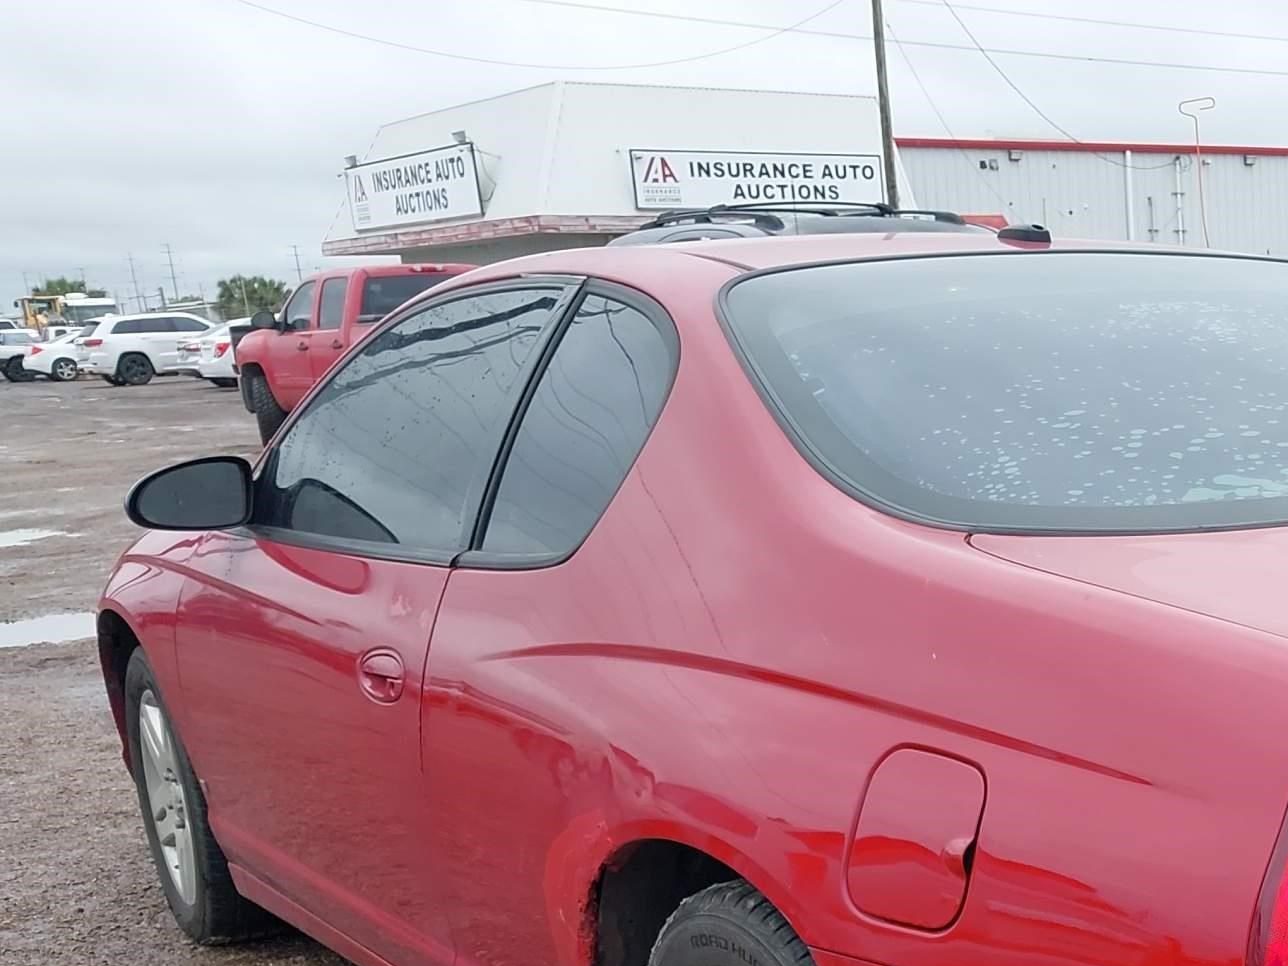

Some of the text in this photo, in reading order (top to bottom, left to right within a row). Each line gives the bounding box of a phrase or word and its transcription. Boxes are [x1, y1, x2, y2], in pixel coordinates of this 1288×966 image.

[372, 156, 465, 193] INSURANCE AUTO
[689, 161, 875, 180] INSURANCE AUTO
[395, 187, 449, 216] AUCTIONS
[733, 183, 840, 200] AUCTIONS
